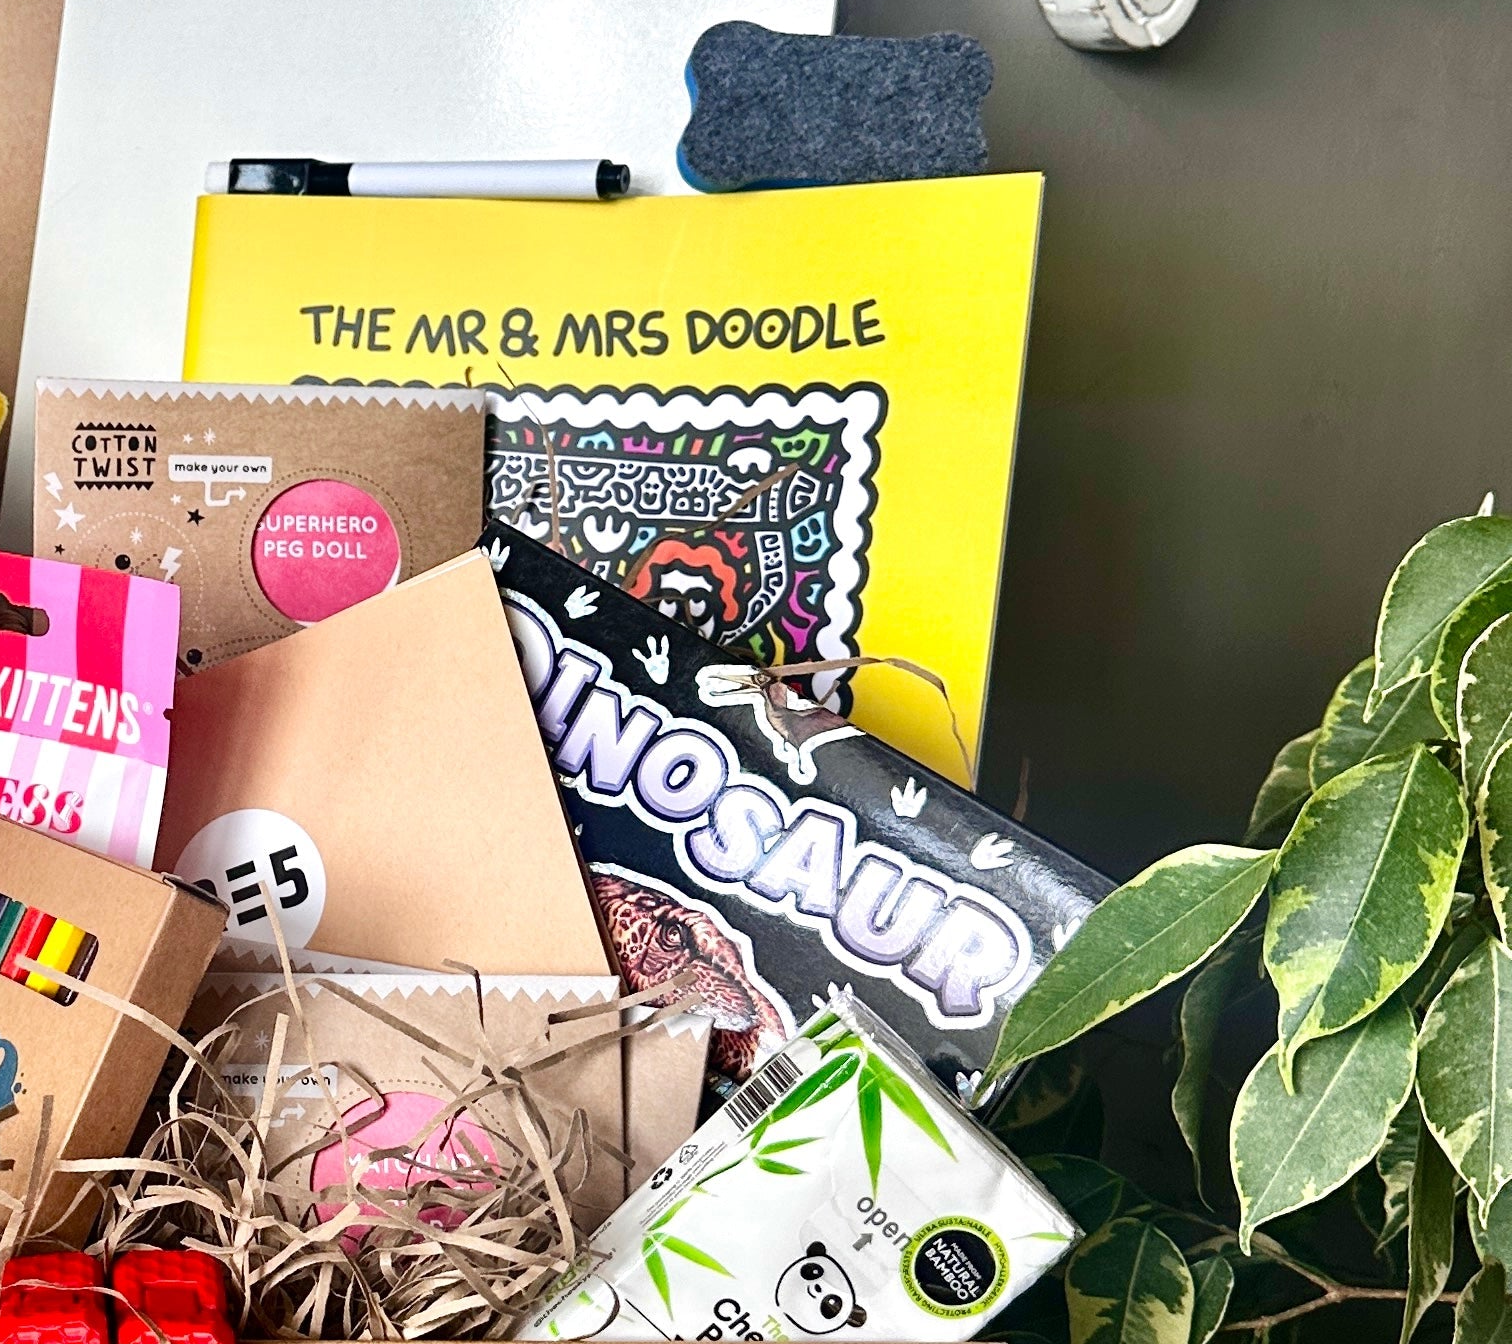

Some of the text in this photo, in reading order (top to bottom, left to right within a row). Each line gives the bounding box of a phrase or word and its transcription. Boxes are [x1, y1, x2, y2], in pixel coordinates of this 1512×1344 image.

[299, 299, 886, 358] THE MR & MRS DOODLE
[71, 434, 157, 454] COTTON
[73, 457, 156, 477] TWIST
[174, 461, 267, 474] make your own
[263, 540, 367, 559] PEG DOLL
[856, 1196, 913, 1253] open
[925, 1247, 968, 1300] BAMBOO
[932, 1237, 980, 1298] NATURAL
